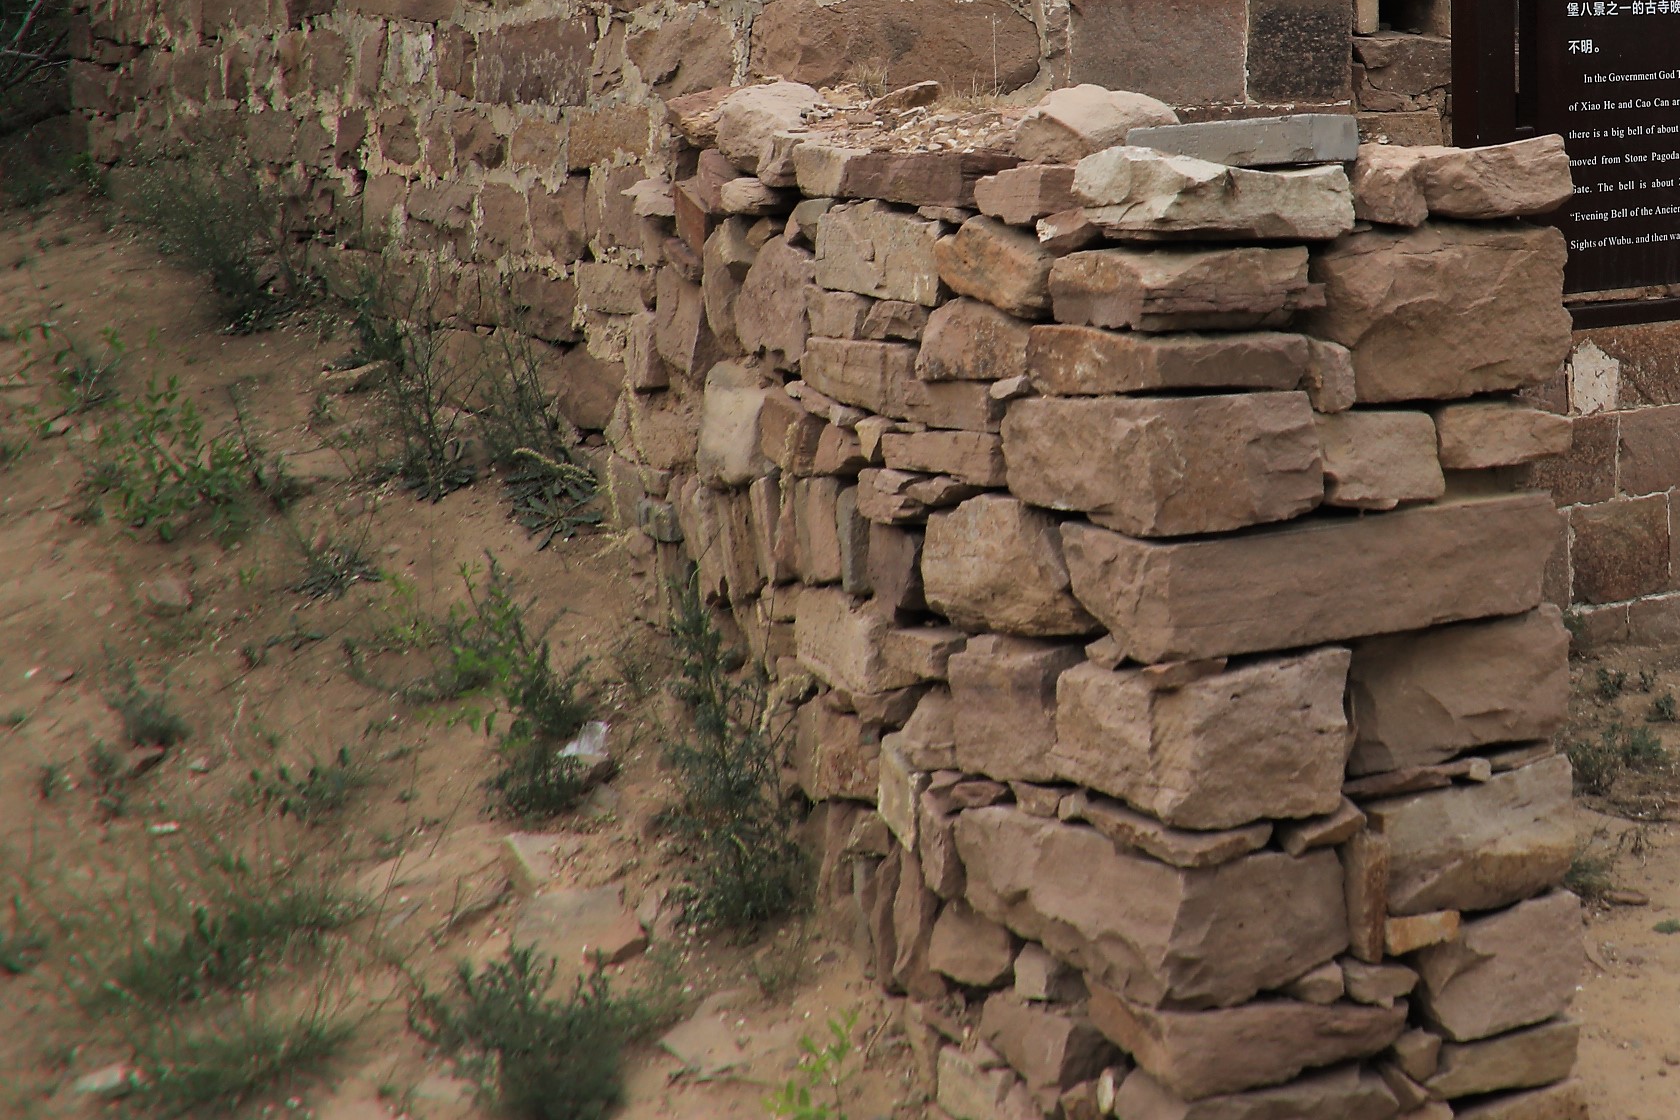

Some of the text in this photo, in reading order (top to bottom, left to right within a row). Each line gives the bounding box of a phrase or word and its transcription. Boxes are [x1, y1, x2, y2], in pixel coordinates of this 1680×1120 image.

[1567, 39, 1600, 55] 不明。
[1584, 74, 1593, 83] In
[1594, 74, 1607, 82] the
[1608, 72, 1657, 82] Government
[1658, 70, 1675, 79] God
[1568, 102, 1579, 111] of
[1580, 101, 1601, 111] Xiao
[1603, 101, 1616, 109] He
[1617, 100, 1633, 108] and
[1635, 99, 1652, 108] Cao
[1653, 98, 1670, 107] Can
[1568, 130, 1590, 139] there
[1611, 127, 1625, 138] big
[1627, 126, 1643, 135] bell
[1645, 125, 1656, 134] of
[1657, 125, 1679, 133] about
[1569, 157, 1597, 167] moved
[1601, 155, 1621, 164] from
[1624, 154, 1648, 162] Stone
[1651, 151, 1680, 162] Pagoda
[1597, 183, 1614, 192] The
[1618, 181, 1635, 190] bell
[1639, 180, 1647, 188] is
[1651, 179, 1674, 187] about
[1611, 209, 1628, 218] Bell
[1629, 207, 1640, 216] of
[1640, 207, 1653, 215] the
[1570, 239, 1597, 251] Sights
[1597, 237, 1608, 246] of
[1635, 234, 1650, 243] and
[1651, 233, 1668, 241] then
